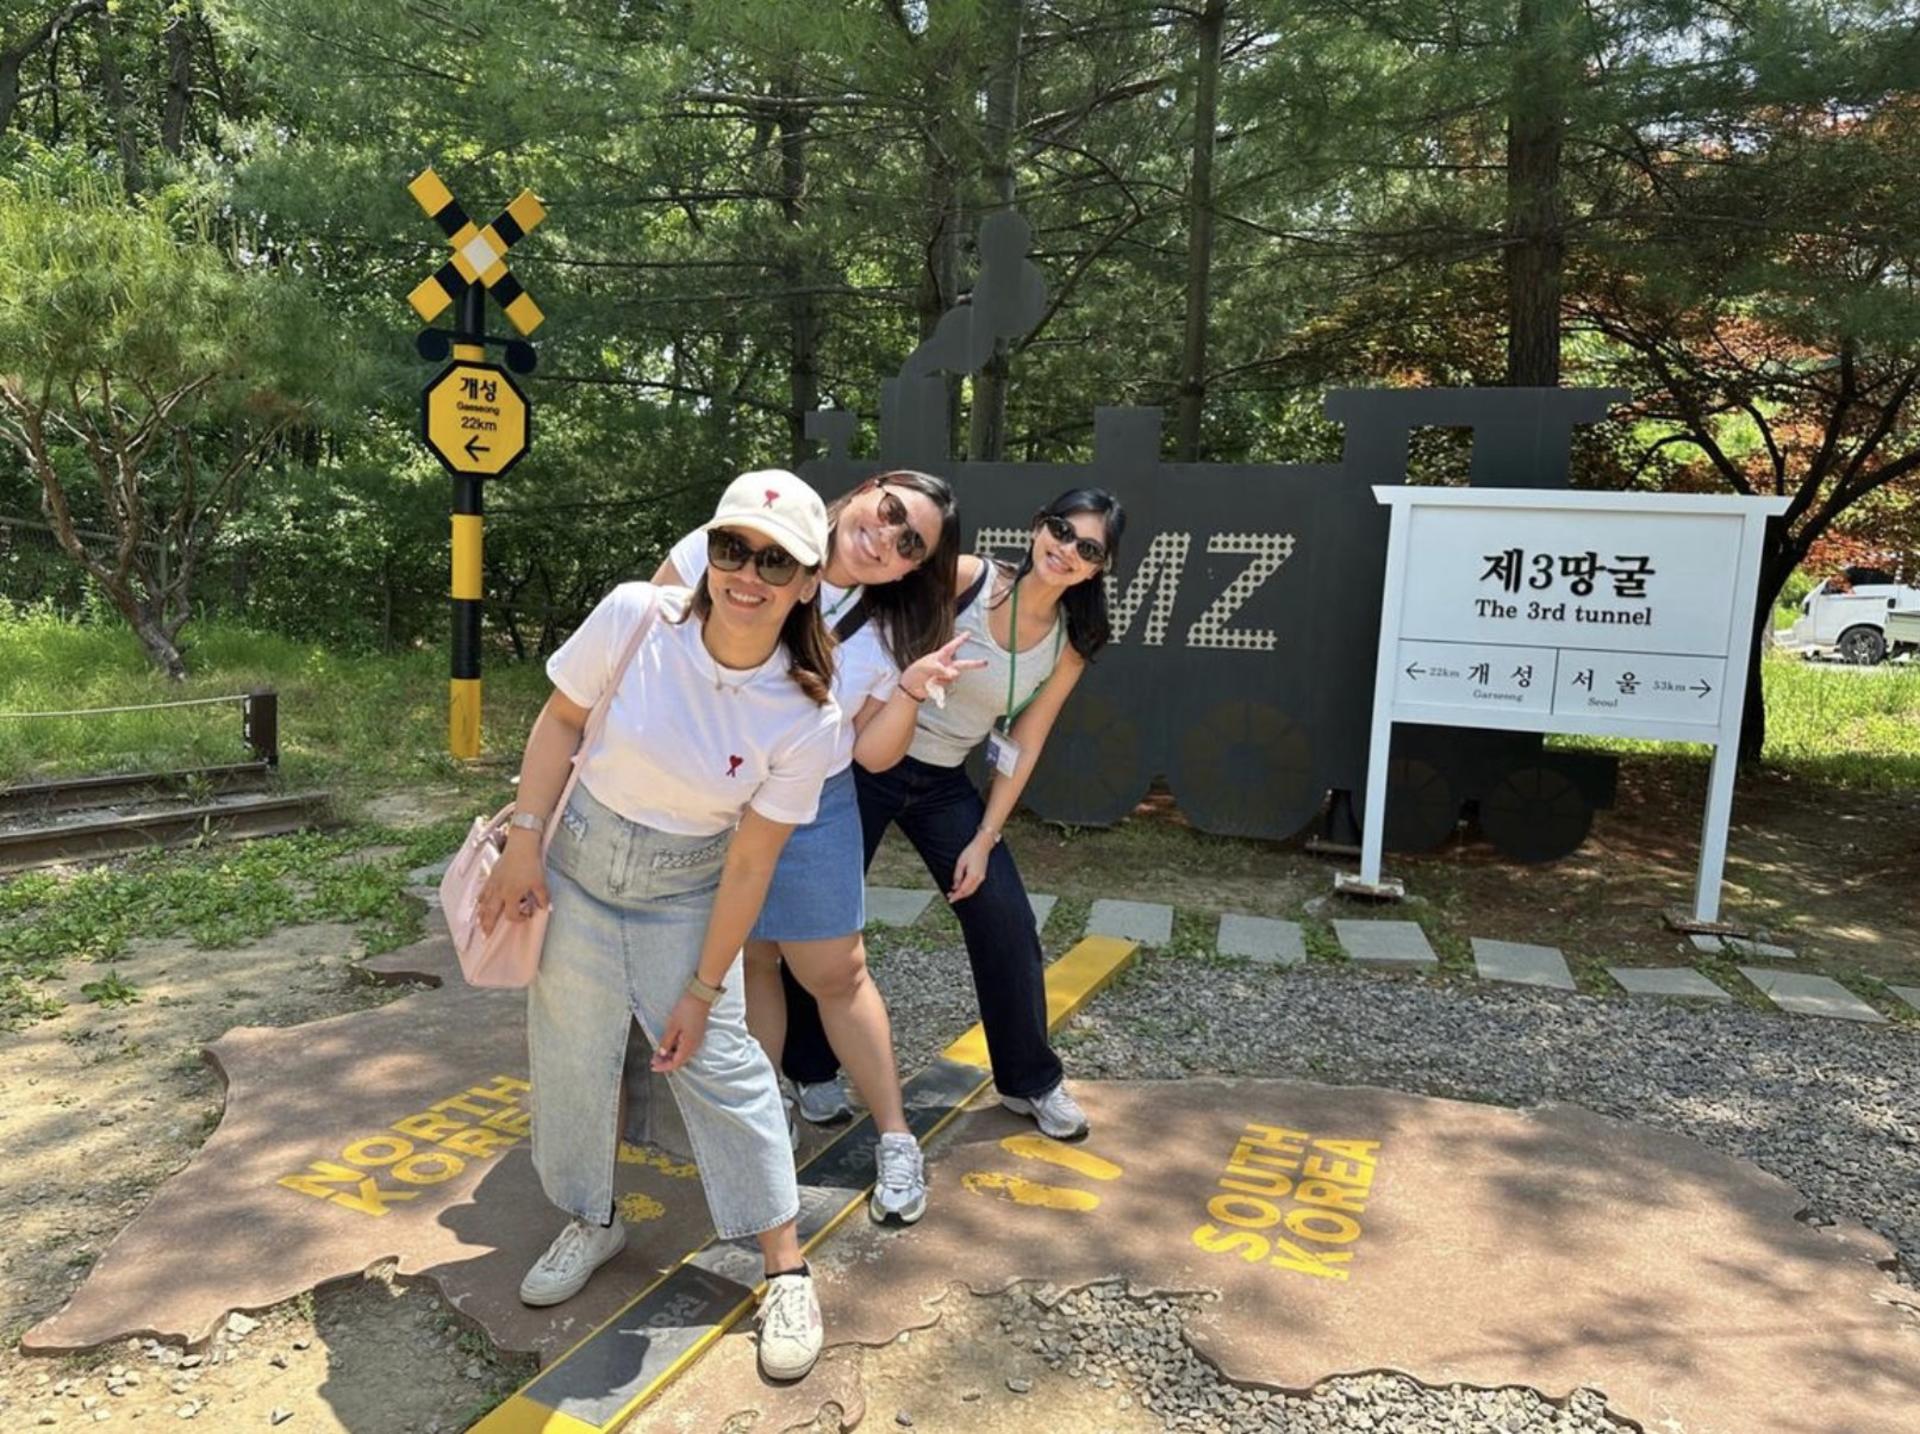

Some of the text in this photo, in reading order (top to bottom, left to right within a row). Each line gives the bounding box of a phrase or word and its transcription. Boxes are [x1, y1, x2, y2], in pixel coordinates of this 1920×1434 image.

[459, 377, 497, 402] 개성
[460, 416, 497, 432] 22km
[974, 527, 1296, 651] MZ
[1480, 548, 1656, 599] 제3땅굴
[1475, 599, 1652, 626] The 3rd tunnel
[1429, 667, 1460, 678] 22km
[1587, 697, 1618, 707] Seoul
[277, 1074, 532, 1195] NORTH
[329, 1105, 532, 1218] KORE
[1192, 1123, 1310, 1263] SOUTH
[1269, 1138, 1381, 1281] KOREA
